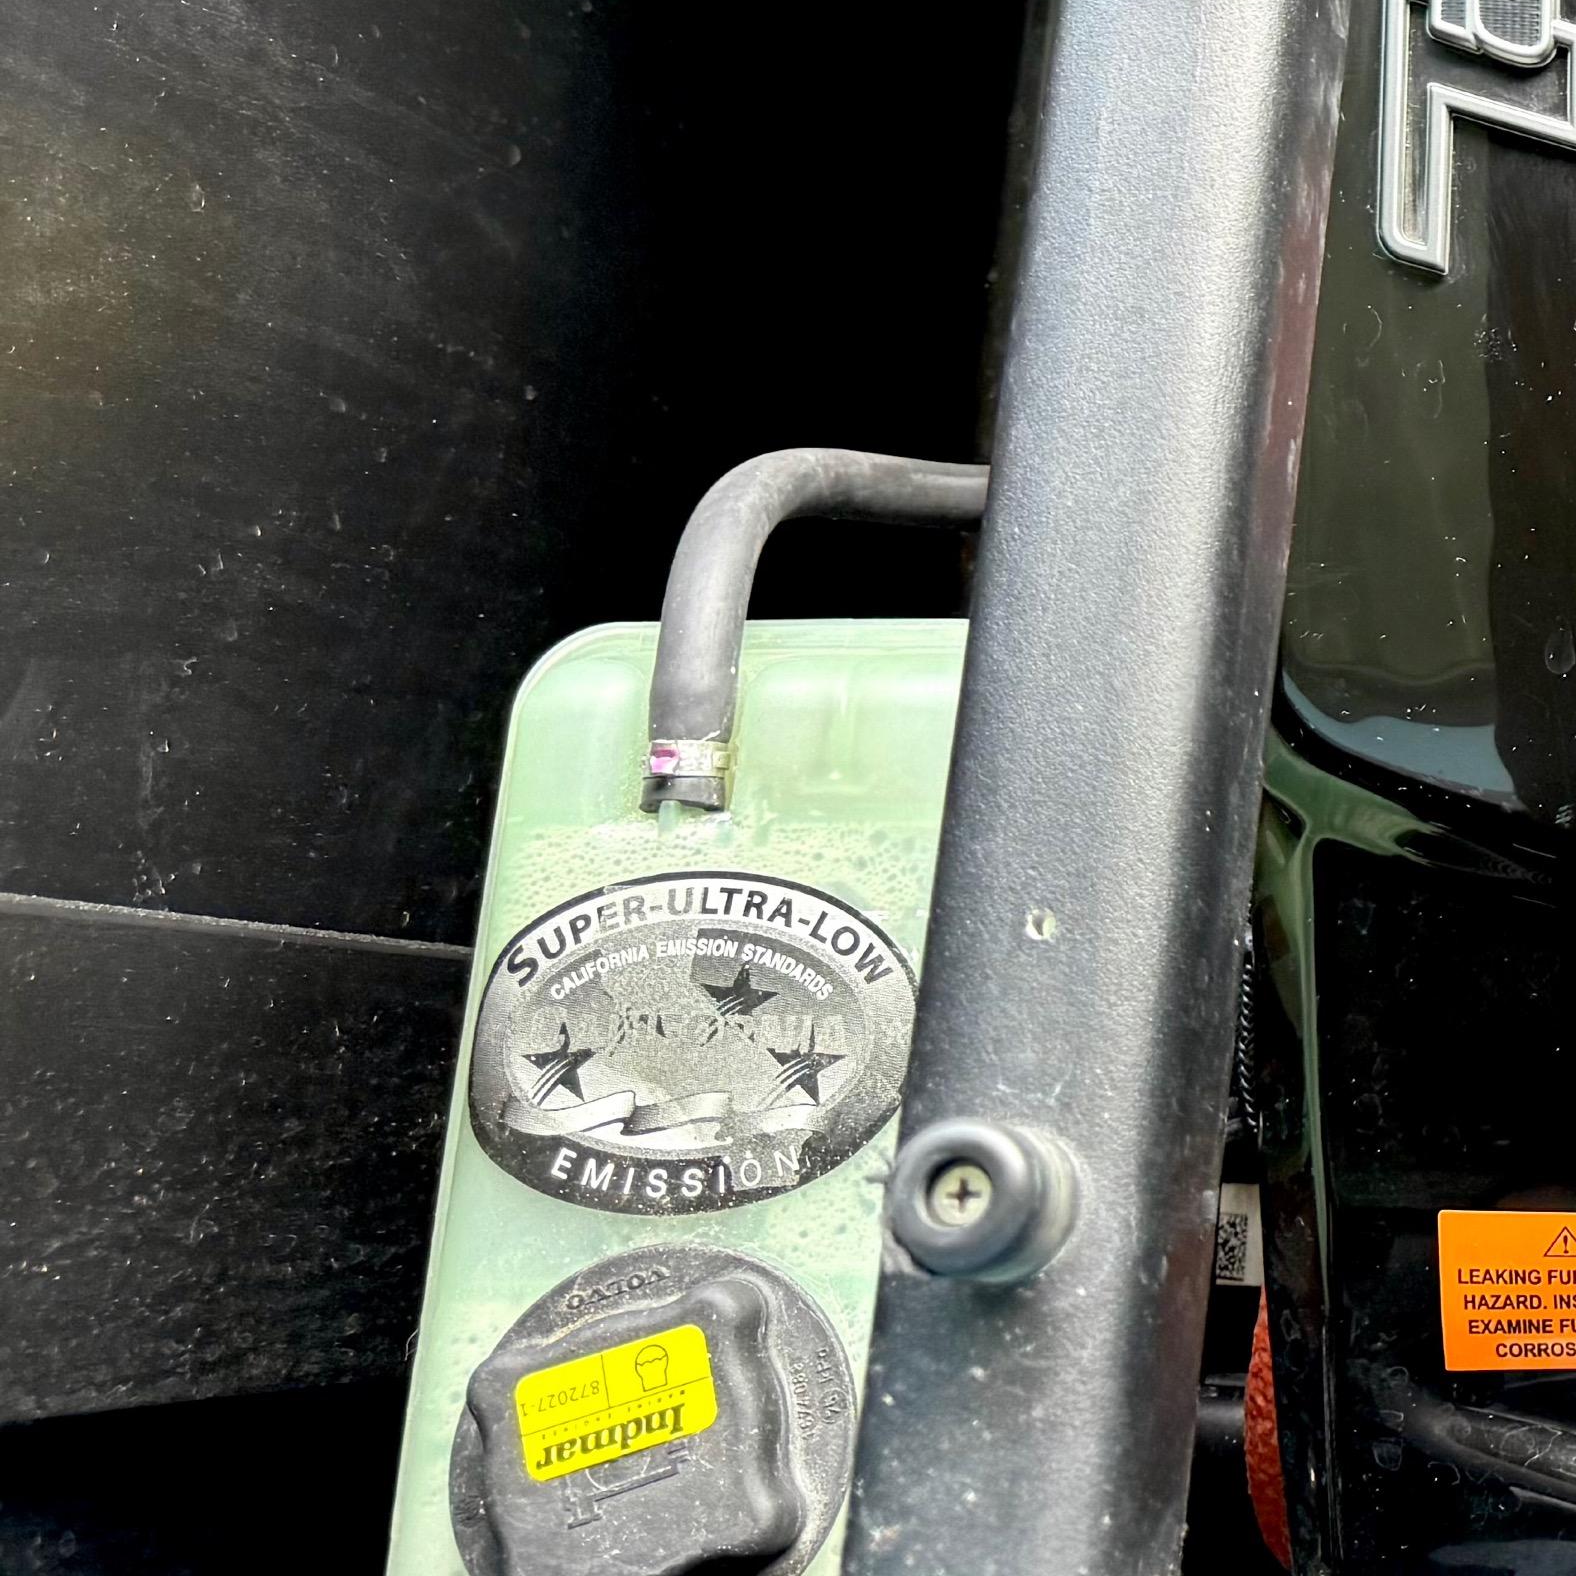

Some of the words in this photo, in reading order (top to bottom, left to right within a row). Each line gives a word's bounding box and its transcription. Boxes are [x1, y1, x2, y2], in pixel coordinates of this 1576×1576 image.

[506, 886, 893, 987] SUPER-ULTRA-LOW
[551, 945, 650, 1000] CALIFORNIA
[656, 937, 738, 958] EMISSION
[743, 942, 833, 1000] STANDARDS
[551, 1146, 799, 1198] EMISSION
[565, 1265, 670, 1310] VOLVO
[1457, 1269, 1541, 1285] LEAKING
[1463, 1295, 1548, 1310] HAZARD.
[1468, 1319, 1553, 1334] EXAMINE
[536, 1404, 686, 1471] Indmar
